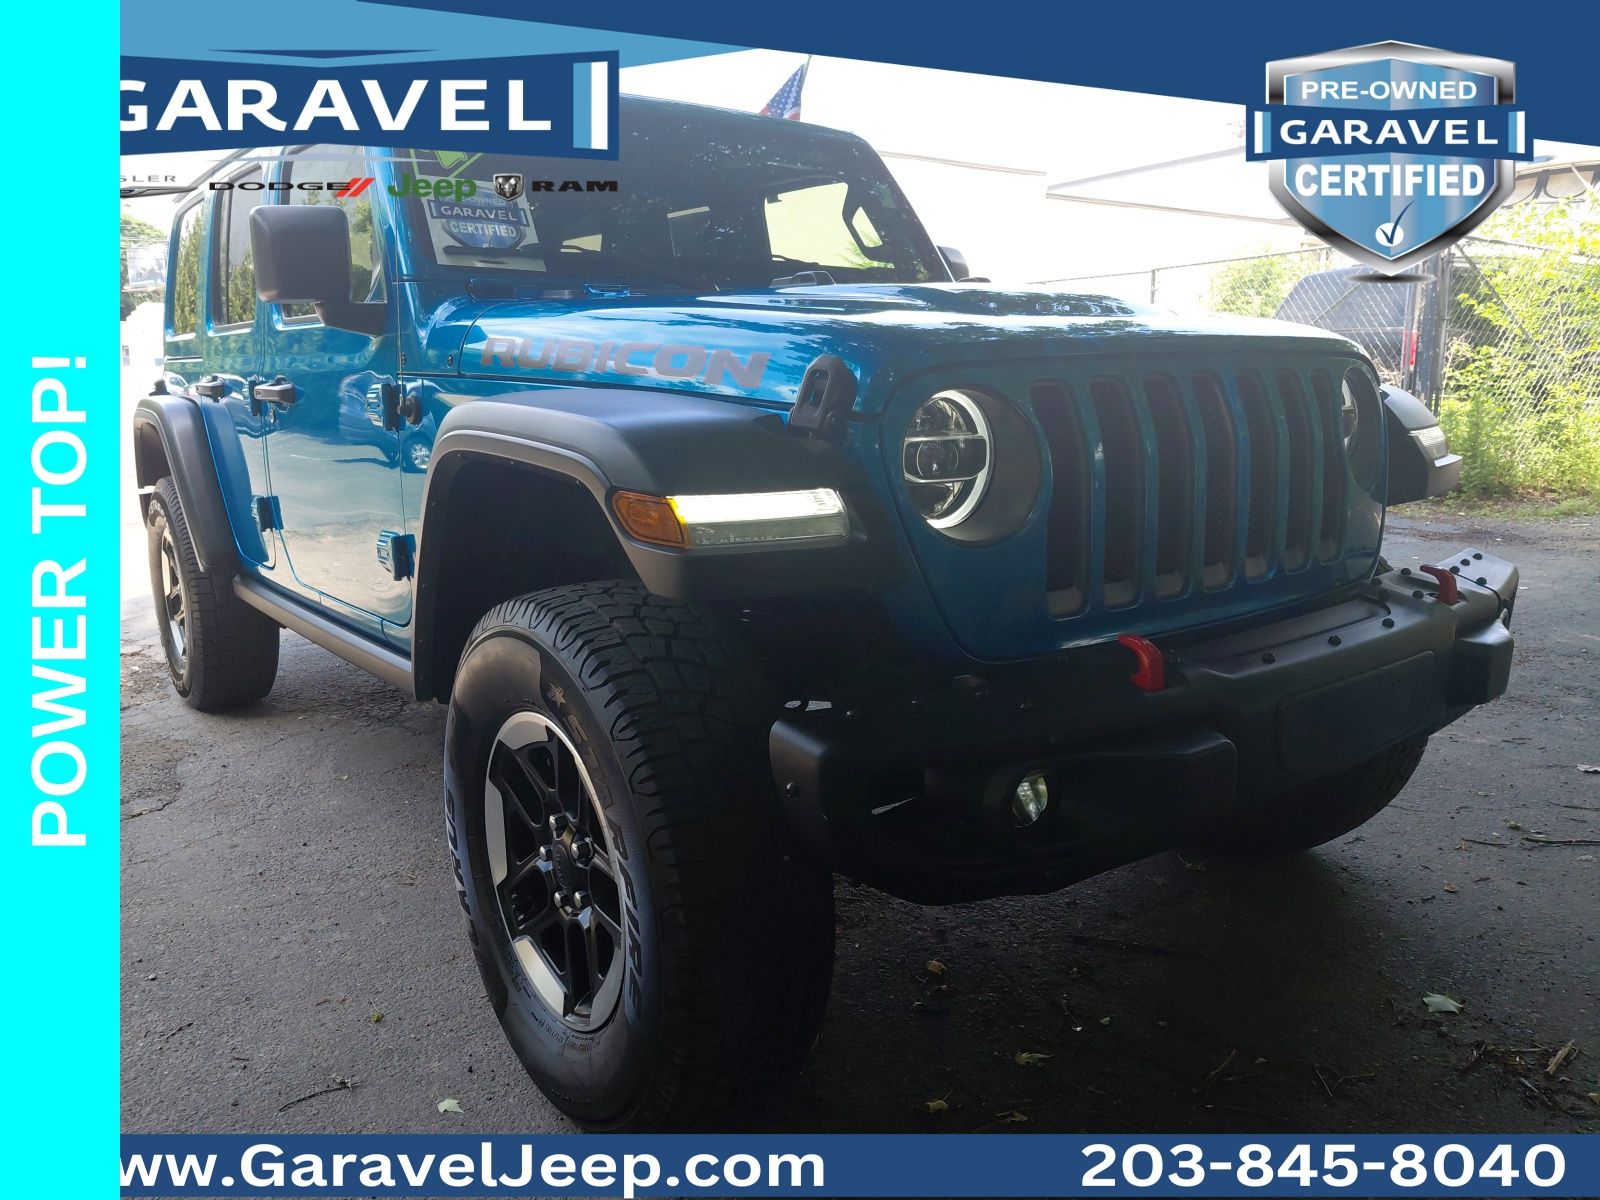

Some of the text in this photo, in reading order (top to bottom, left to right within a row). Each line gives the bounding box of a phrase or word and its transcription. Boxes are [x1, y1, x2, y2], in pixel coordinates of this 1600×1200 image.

[440, 205, 518, 222] GARAVEL
[449, 221, 517, 238] CERTIFIED
[480, 336, 772, 389] RUBICON
